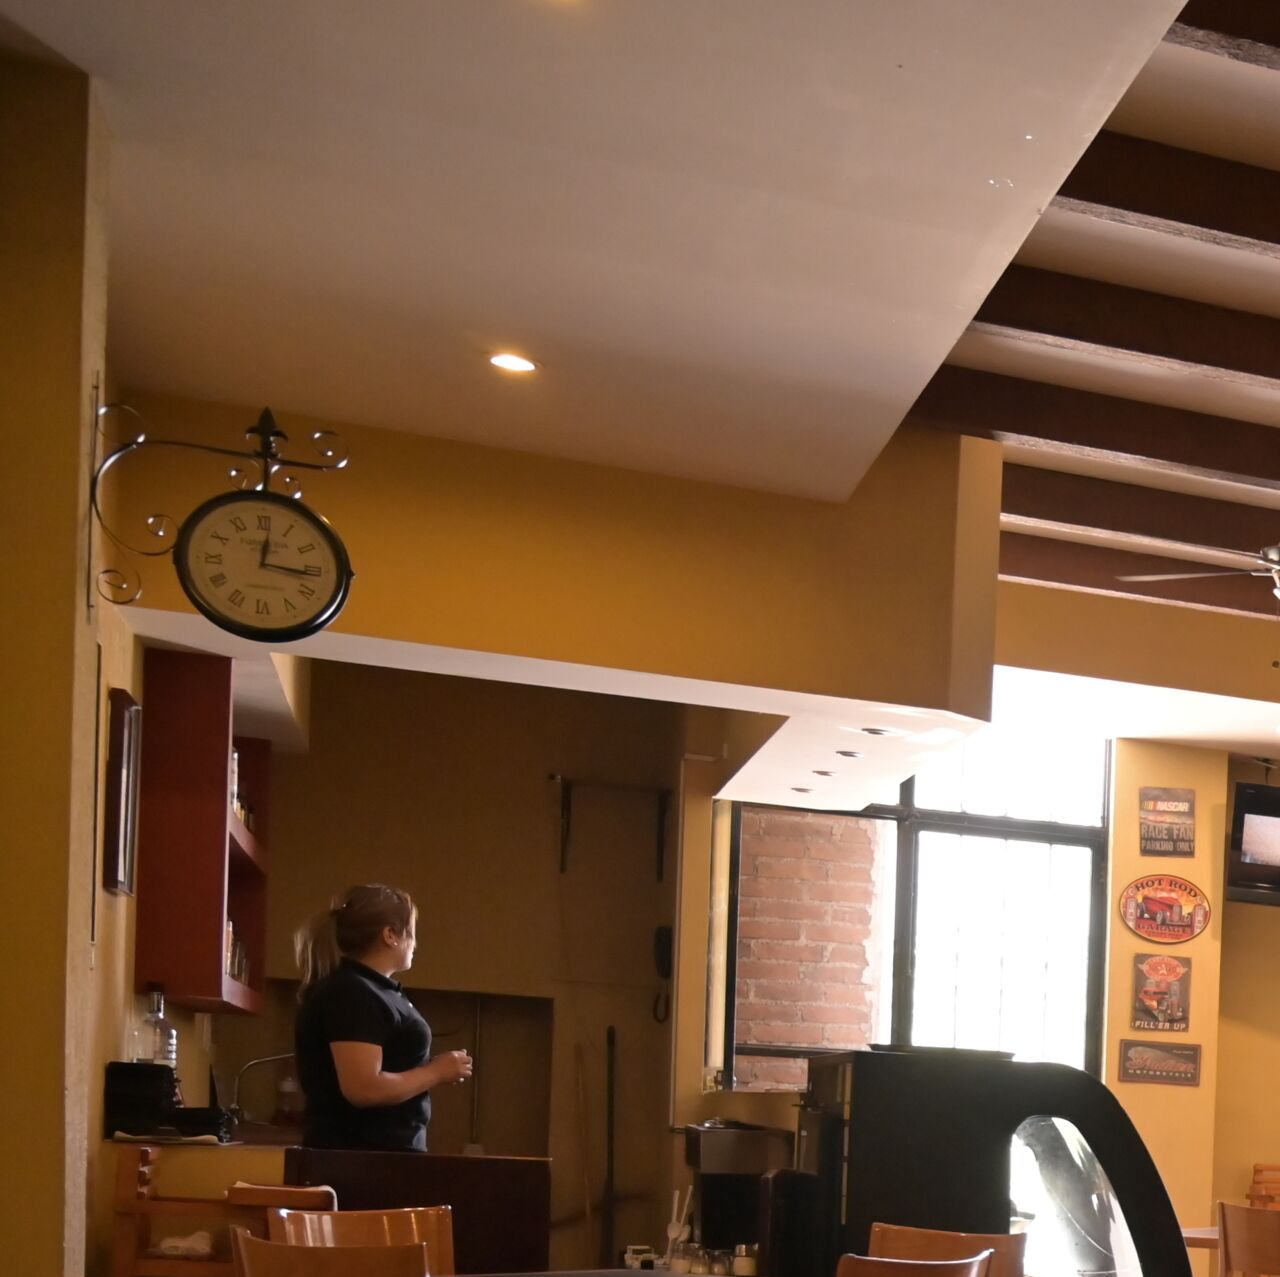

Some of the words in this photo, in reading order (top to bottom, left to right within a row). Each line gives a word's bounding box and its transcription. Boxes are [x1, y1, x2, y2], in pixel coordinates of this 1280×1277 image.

[281, 524, 294, 538] I
[210, 531, 229, 546] X
[1156, 801, 1189, 812] NASCAR
[1142, 824, 1168, 839] RACE
[1173, 824, 1193, 840] FAN
[1142, 840, 1173, 851] PARKING
[1135, 879, 1164, 892] HOT
[1168, 880, 1198, 898] ROD
